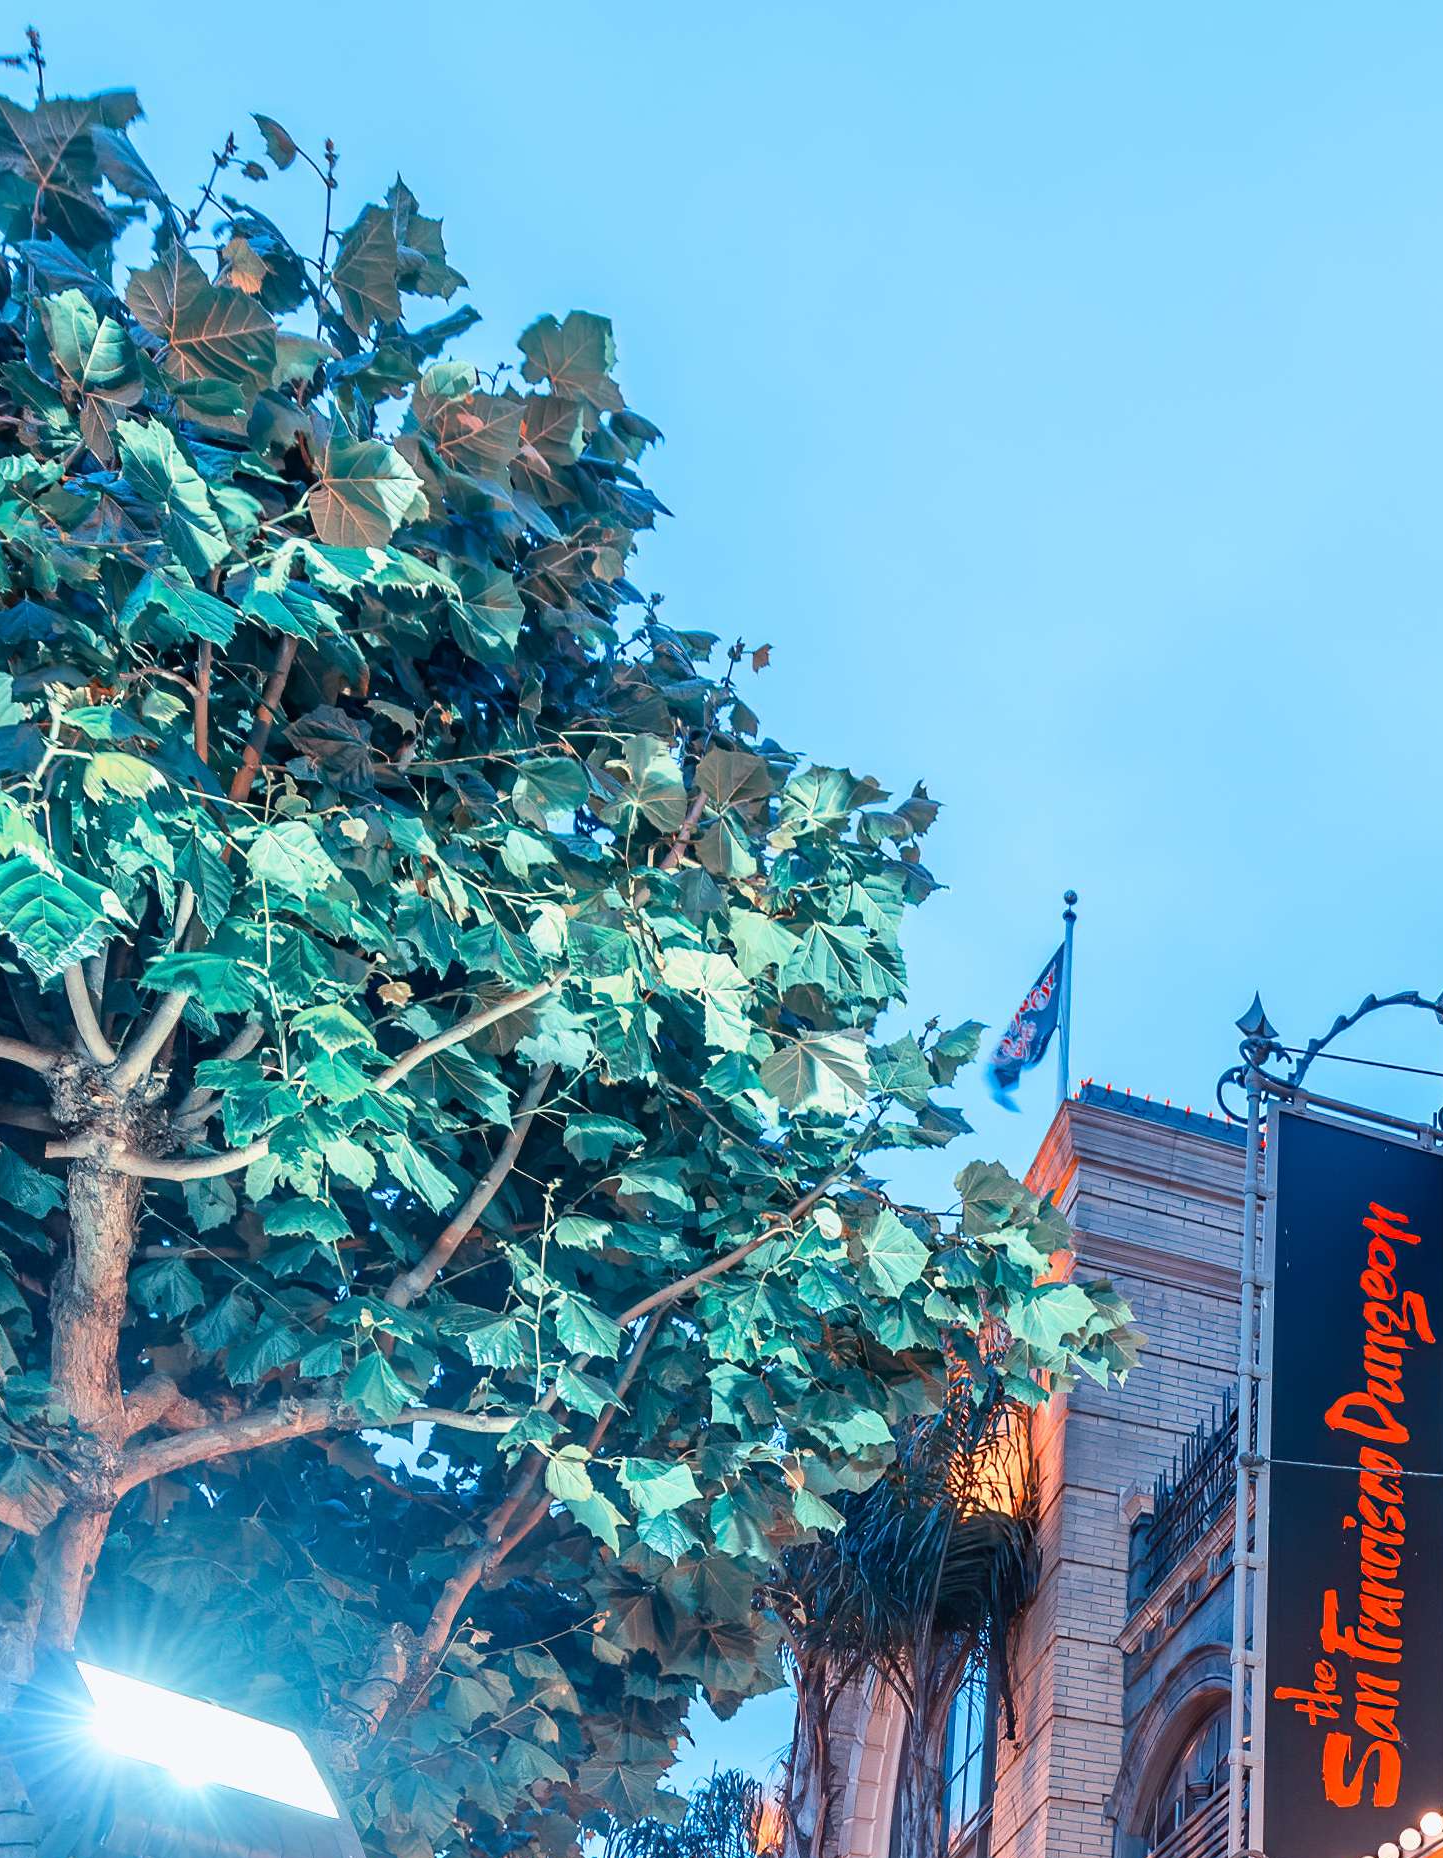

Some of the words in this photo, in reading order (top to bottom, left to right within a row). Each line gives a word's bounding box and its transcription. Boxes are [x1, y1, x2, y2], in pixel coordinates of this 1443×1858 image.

[1324, 1201, 1437, 1444] Dungeon
[1320, 1446, 1406, 1664] Francisco
[1274, 1658, 1342, 1726] the
[1323, 1671, 1401, 1808] San
